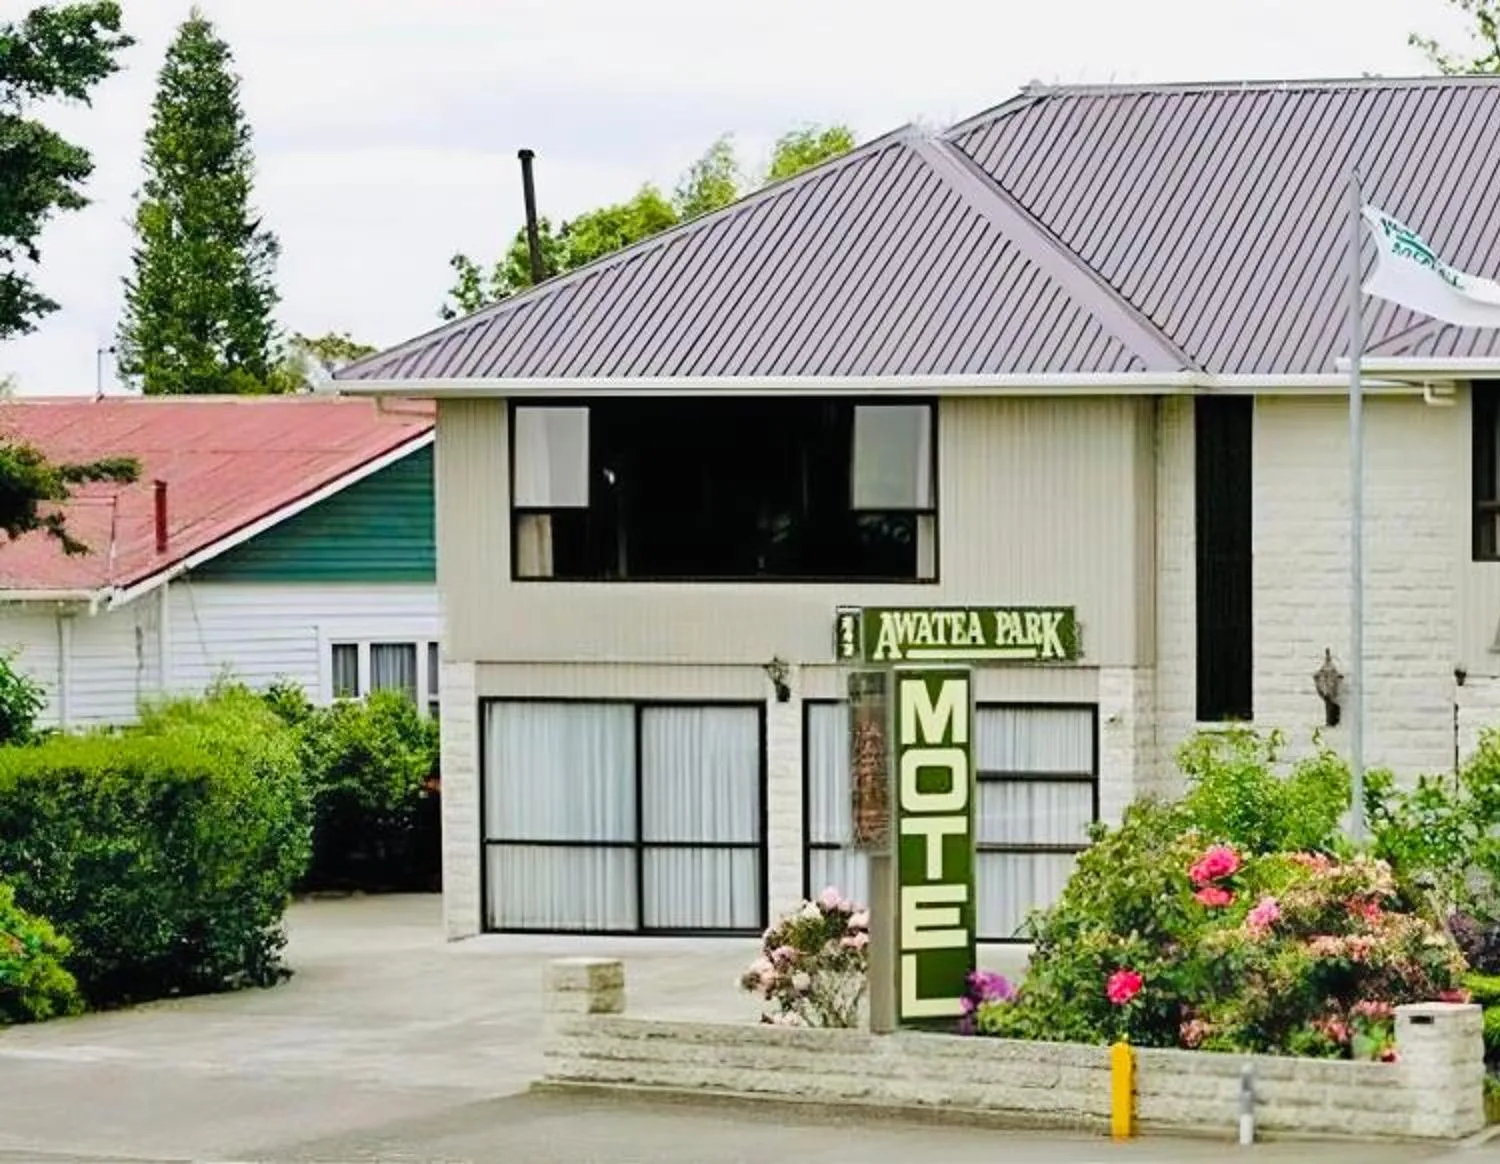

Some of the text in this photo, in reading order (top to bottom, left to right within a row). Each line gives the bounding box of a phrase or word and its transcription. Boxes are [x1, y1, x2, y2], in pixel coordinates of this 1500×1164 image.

[873, 610, 986, 661] AWATEA
[994, 610, 1066, 659] PARK
[900, 678, 968, 1018] MOTEL
